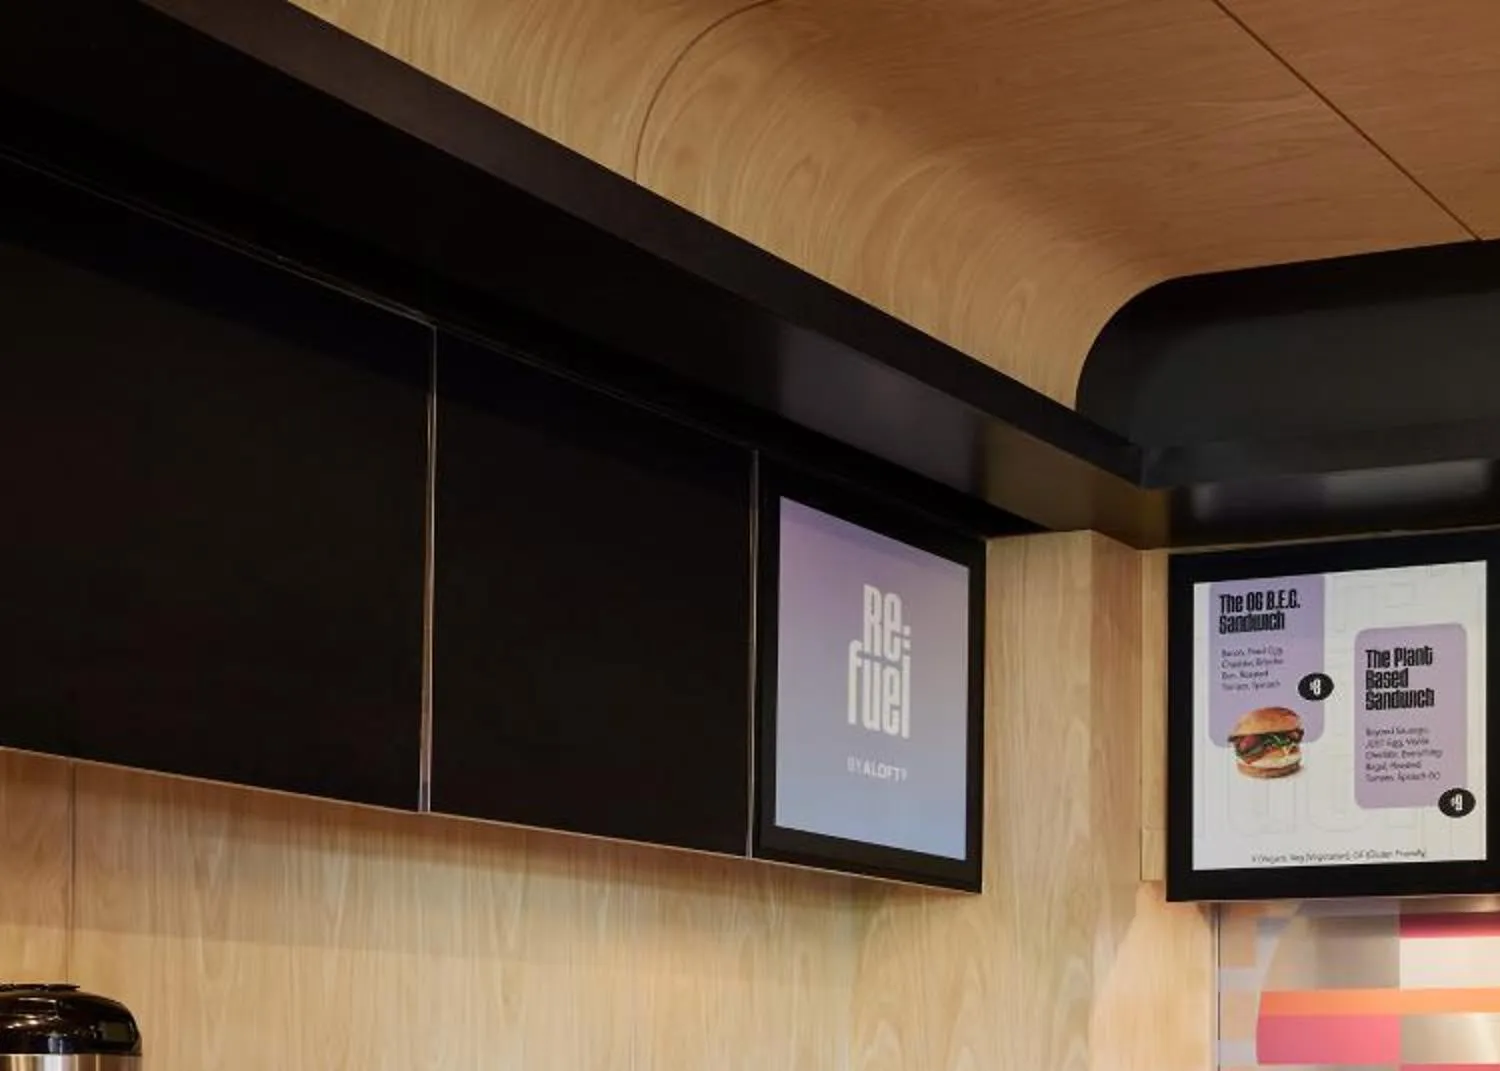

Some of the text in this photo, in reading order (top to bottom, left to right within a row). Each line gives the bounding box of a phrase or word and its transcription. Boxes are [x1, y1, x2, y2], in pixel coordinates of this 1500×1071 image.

[1219, 593, 1243, 614] The
[1219, 611, 1285, 634] Sandwich
[1365, 645, 1433, 669] The Plant
[847, 639, 911, 738] fuel
[1365, 667, 1409, 690] Based
[1365, 687, 1435, 711] Sandwich
